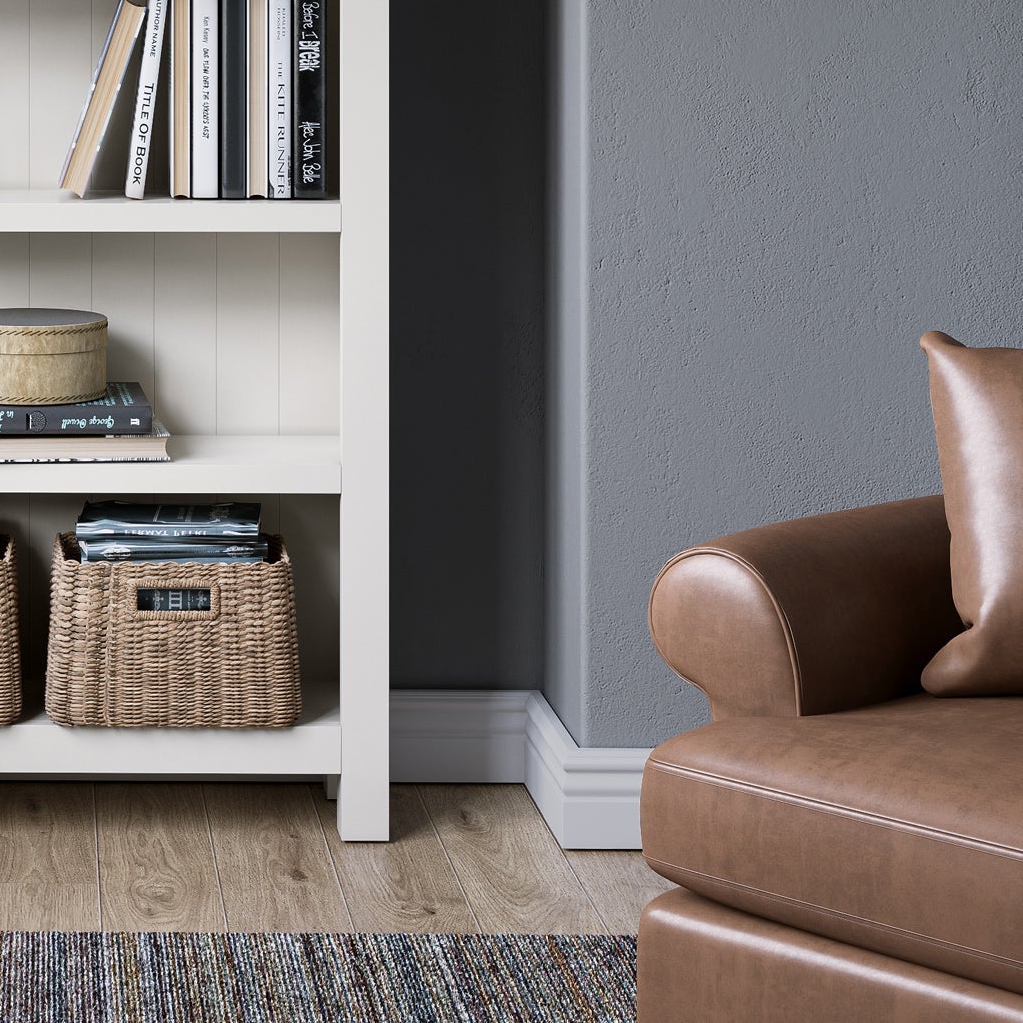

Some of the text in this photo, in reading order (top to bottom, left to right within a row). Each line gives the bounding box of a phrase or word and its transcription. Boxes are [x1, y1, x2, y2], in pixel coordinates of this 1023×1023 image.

[302, 2, 320, 30] Before
[150, 32, 158, 57] NAME
[302, 31, 317, 39] I
[140, 83, 154, 120] TITLE
[132, 146, 146, 185] BOOK
[277, 126, 285, 194] RUNNER
[301, 121, 321, 184] Alec John Belle
[6, 410, 13, 418] in
[61, 416, 114, 429] George Orwell
